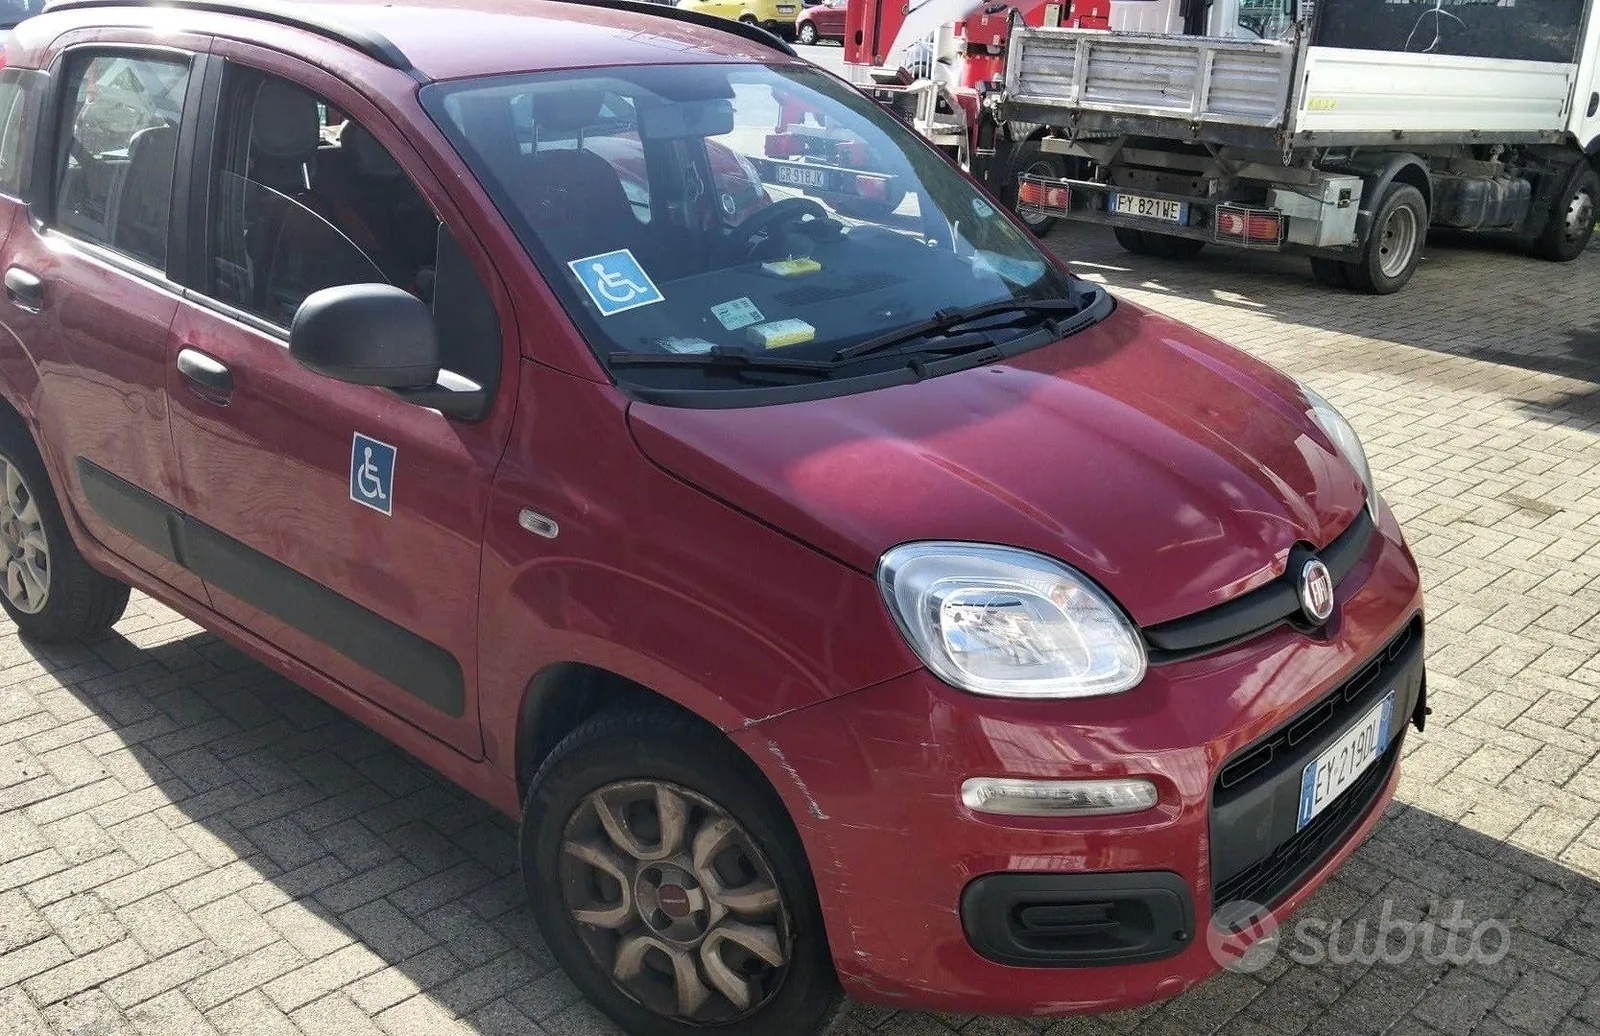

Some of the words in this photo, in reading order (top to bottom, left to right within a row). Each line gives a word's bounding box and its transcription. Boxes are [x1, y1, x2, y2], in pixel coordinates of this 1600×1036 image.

[1118, 195, 1134, 212] FY
[1314, 756, 1336, 806] EY
[1337, 718, 1377, 785] 219DL
